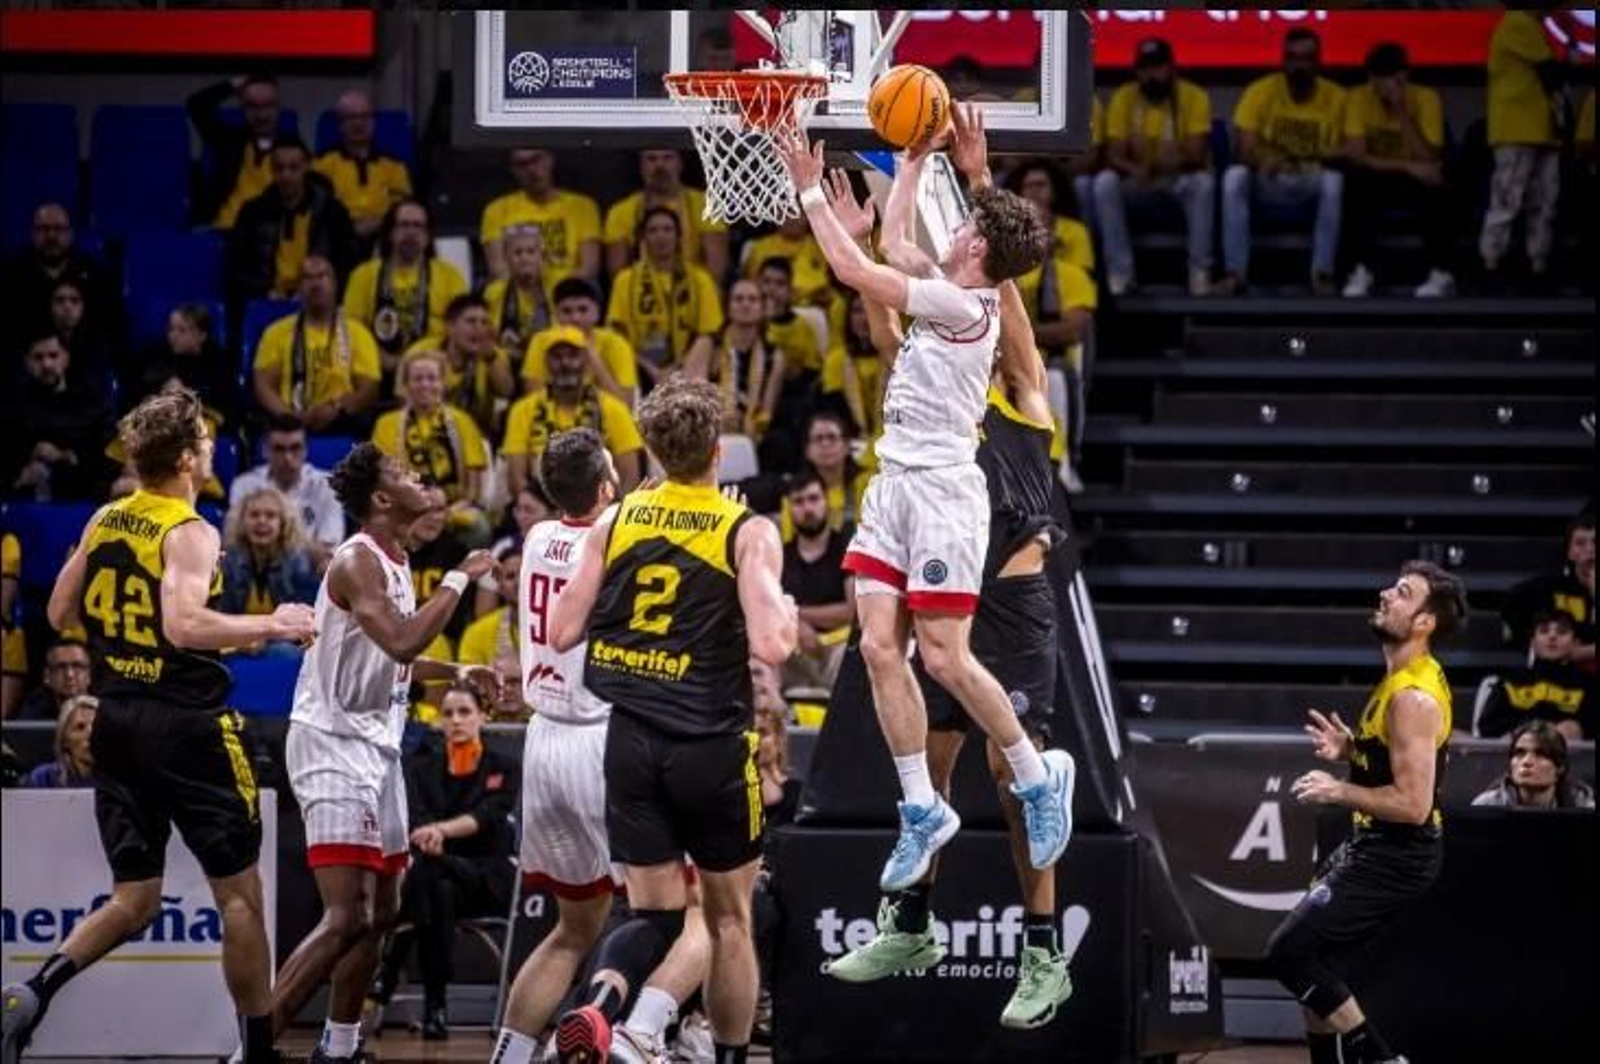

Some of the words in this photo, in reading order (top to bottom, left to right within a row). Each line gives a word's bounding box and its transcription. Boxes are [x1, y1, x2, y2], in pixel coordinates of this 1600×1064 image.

[624, 505, 725, 532] KOSTADINOV
[84, 567, 159, 648] 42
[629, 563, 681, 635] 2
